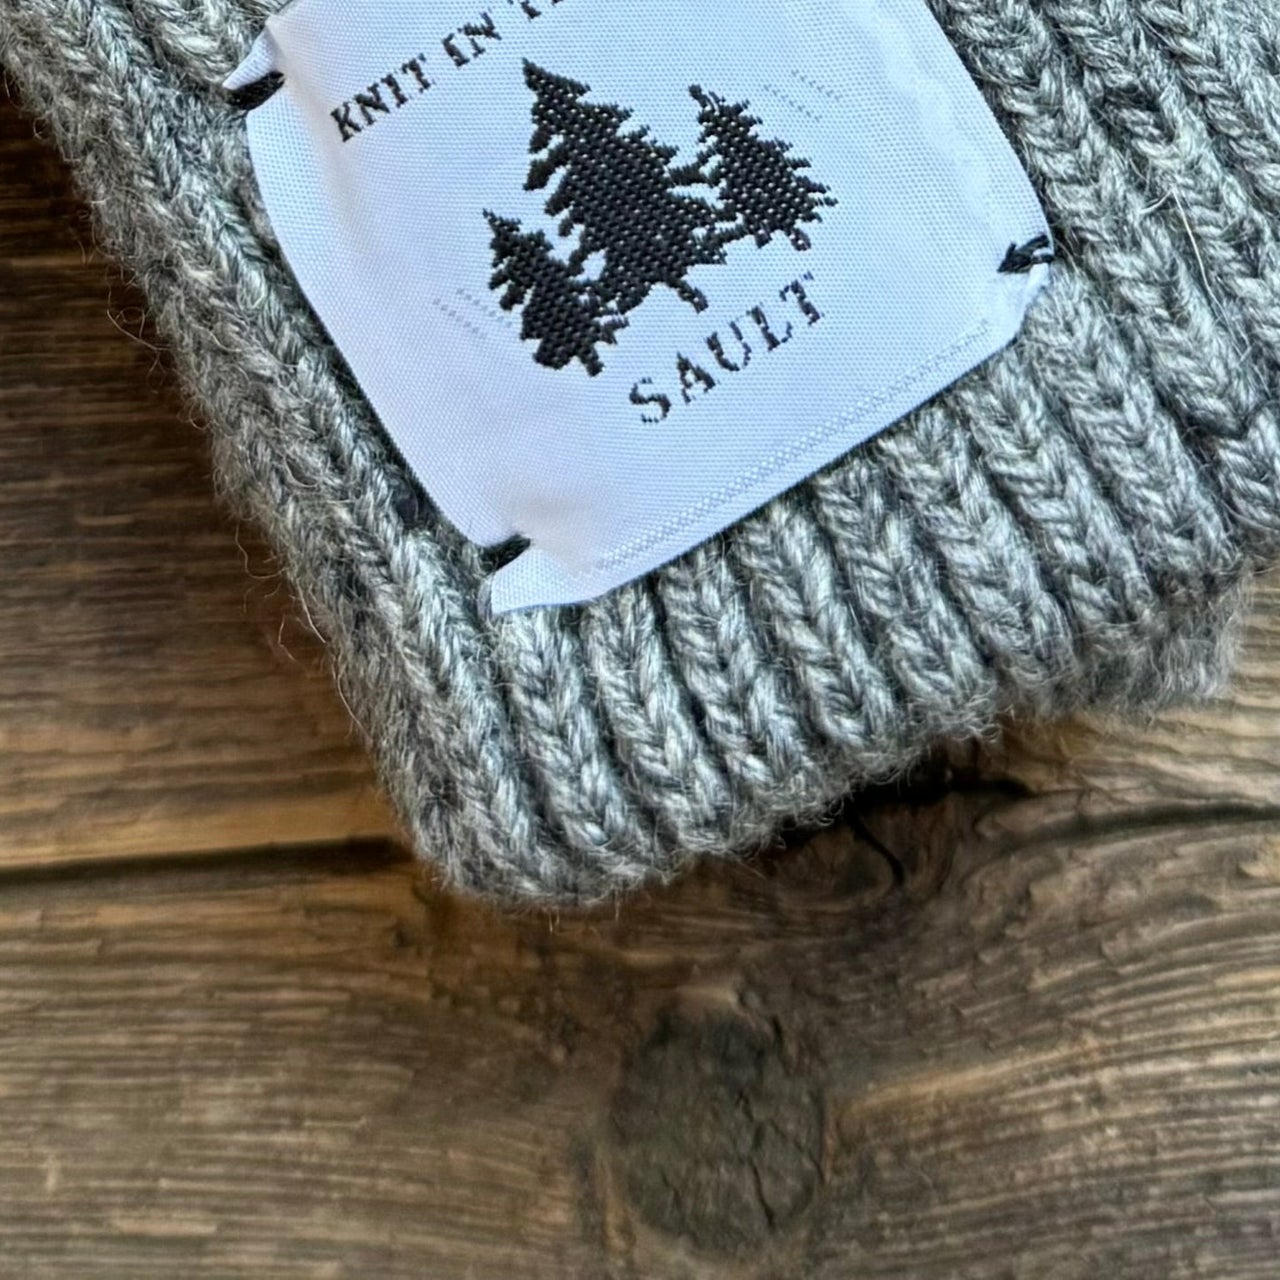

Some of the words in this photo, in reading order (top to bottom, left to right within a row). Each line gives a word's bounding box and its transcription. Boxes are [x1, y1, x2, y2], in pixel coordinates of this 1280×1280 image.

[330, 53, 435, 143] KNIT
[442, 10, 502, 68] IN
[628, 270, 826, 424] SAULT
